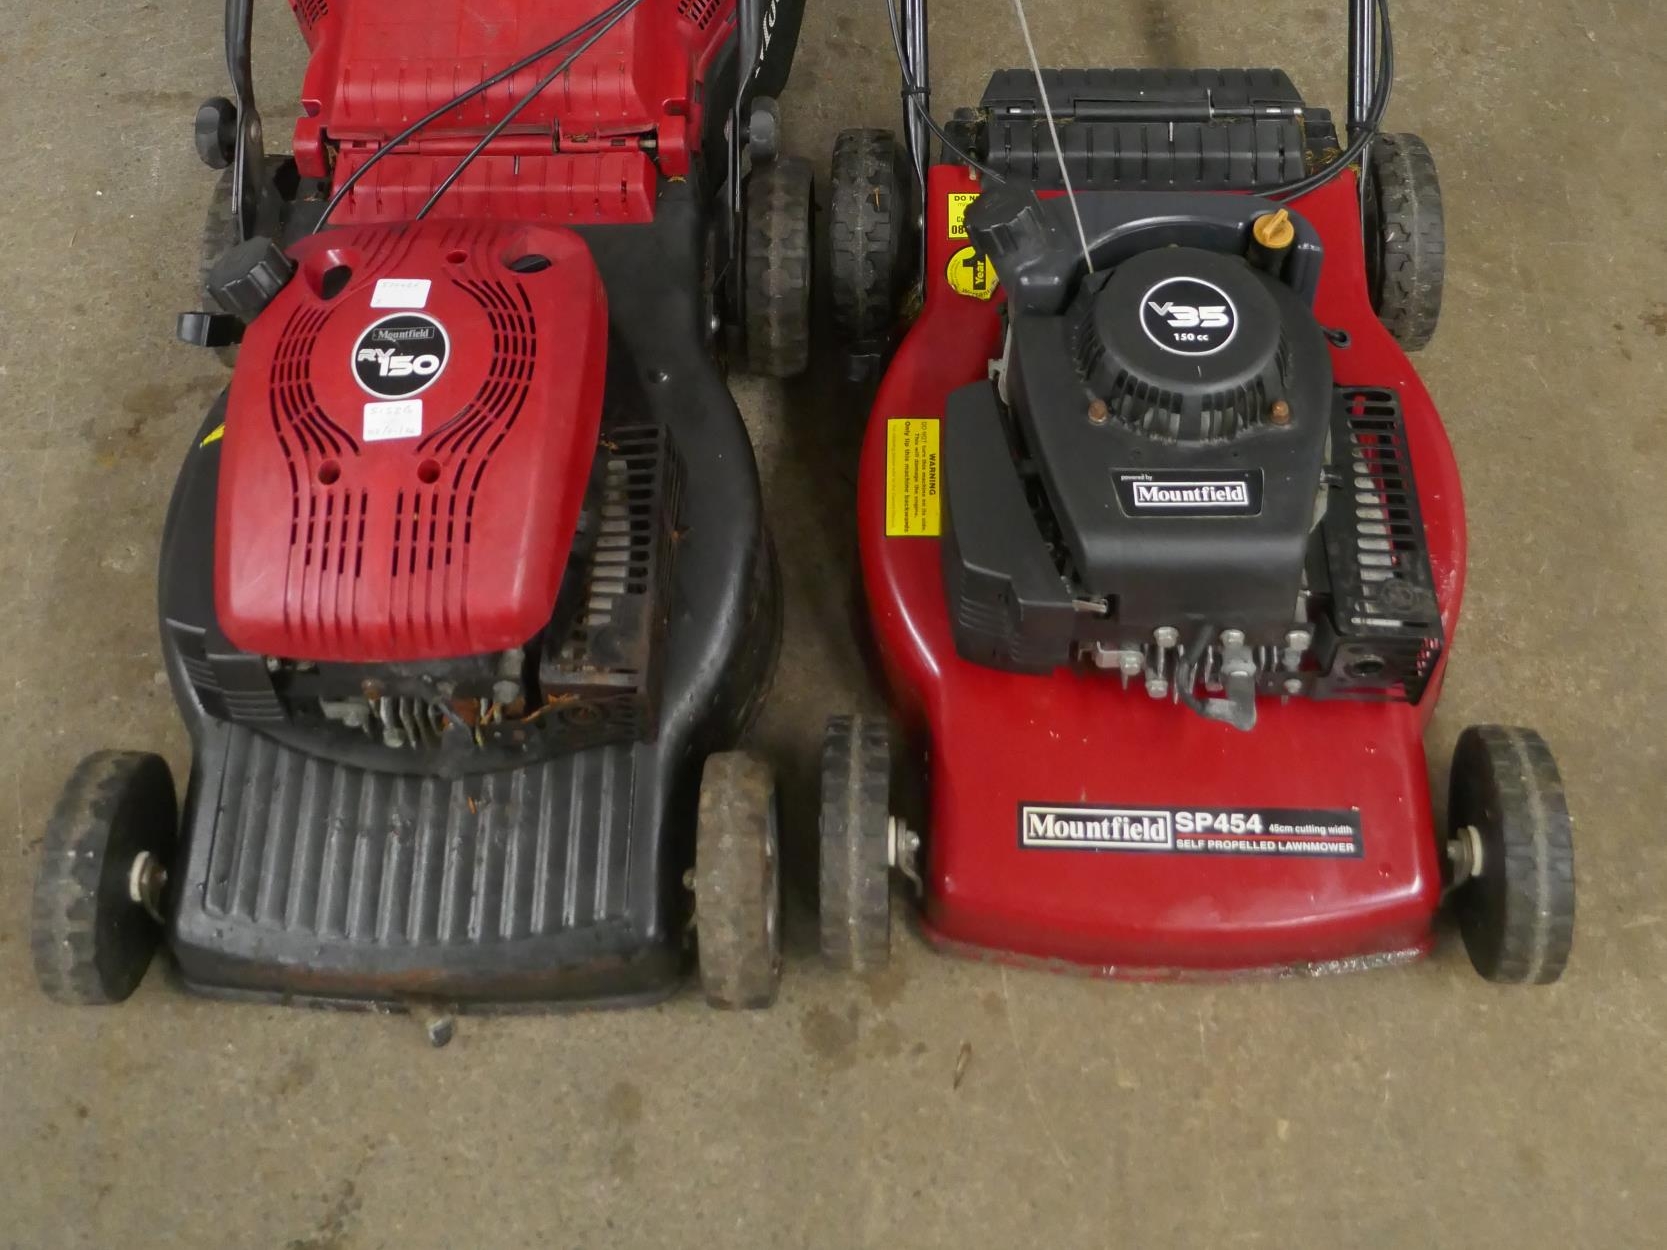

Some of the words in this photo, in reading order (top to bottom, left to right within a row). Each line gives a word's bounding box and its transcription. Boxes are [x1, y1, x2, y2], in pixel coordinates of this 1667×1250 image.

[974, 260, 985, 285] Year
[378, 328, 429, 340] Mountfield
[1173, 333, 1194, 341] 150
[903, 421, 911, 436] Only
[1138, 486, 1244, 502] Mountfield
[1028, 813, 1167, 843] Mountfield
[1175, 811, 1263, 834] SP454
[1269, 824, 1293, 834] 45cm
[1295, 824, 1327, 836] cutting
[1328, 825, 1353, 835] width
[1176, 839, 1205, 849] SELF
[1207, 840, 1276, 851] PROPELLED
[1278, 841, 1355, 853] LAWNMOWER
